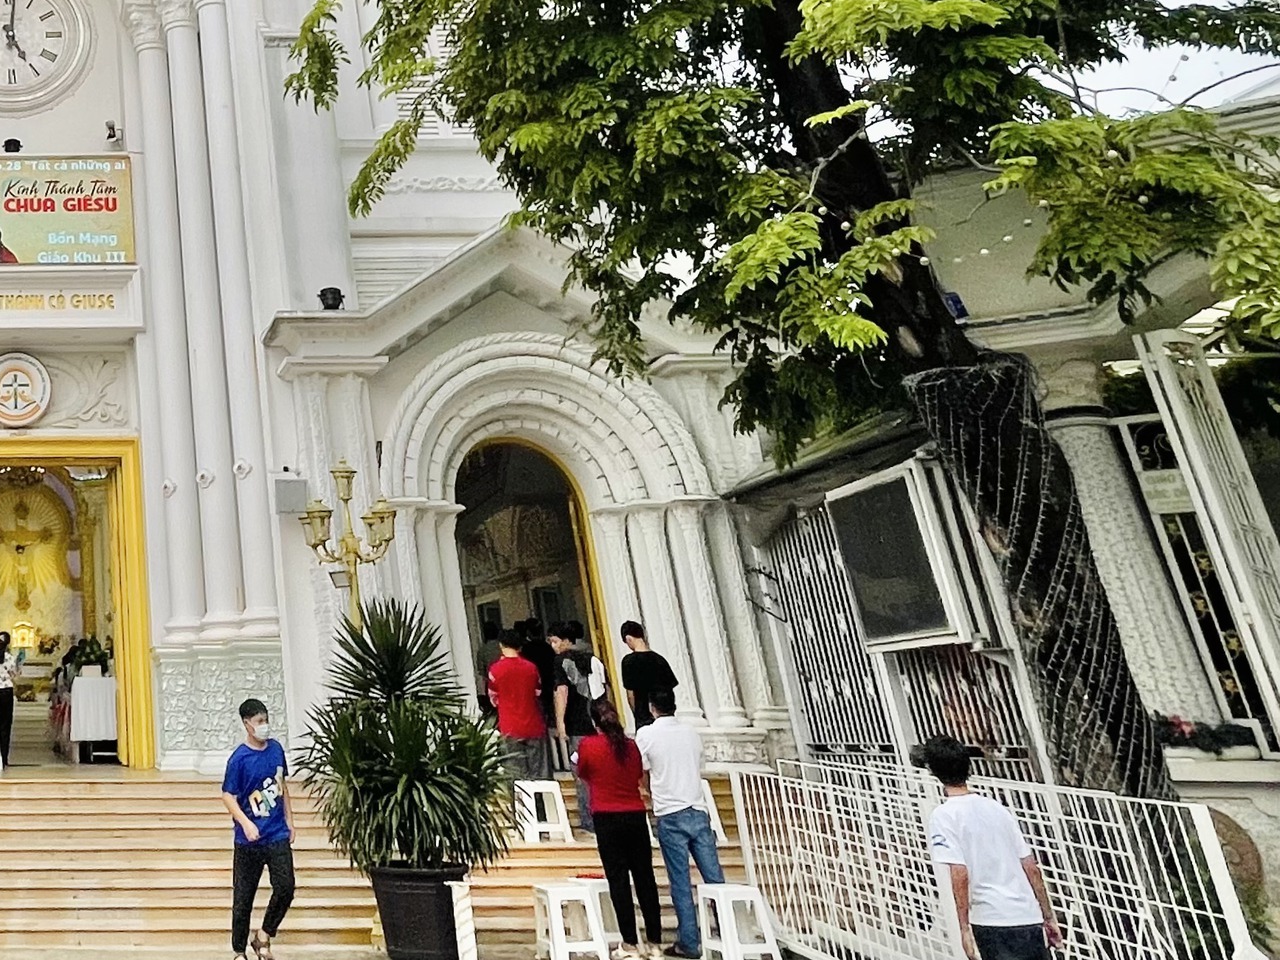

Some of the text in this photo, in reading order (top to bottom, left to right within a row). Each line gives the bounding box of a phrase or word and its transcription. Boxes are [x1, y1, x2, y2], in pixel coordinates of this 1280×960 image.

[71, 160, 111, 172] những
[44, 179, 86, 197] Thánh
[62, 194, 117, 212] GIÊSU
[79, 232, 117, 246] Mạng
[37, 250, 126, 263] Giáo Khu III
[70, 293, 114, 309] GIUSE
